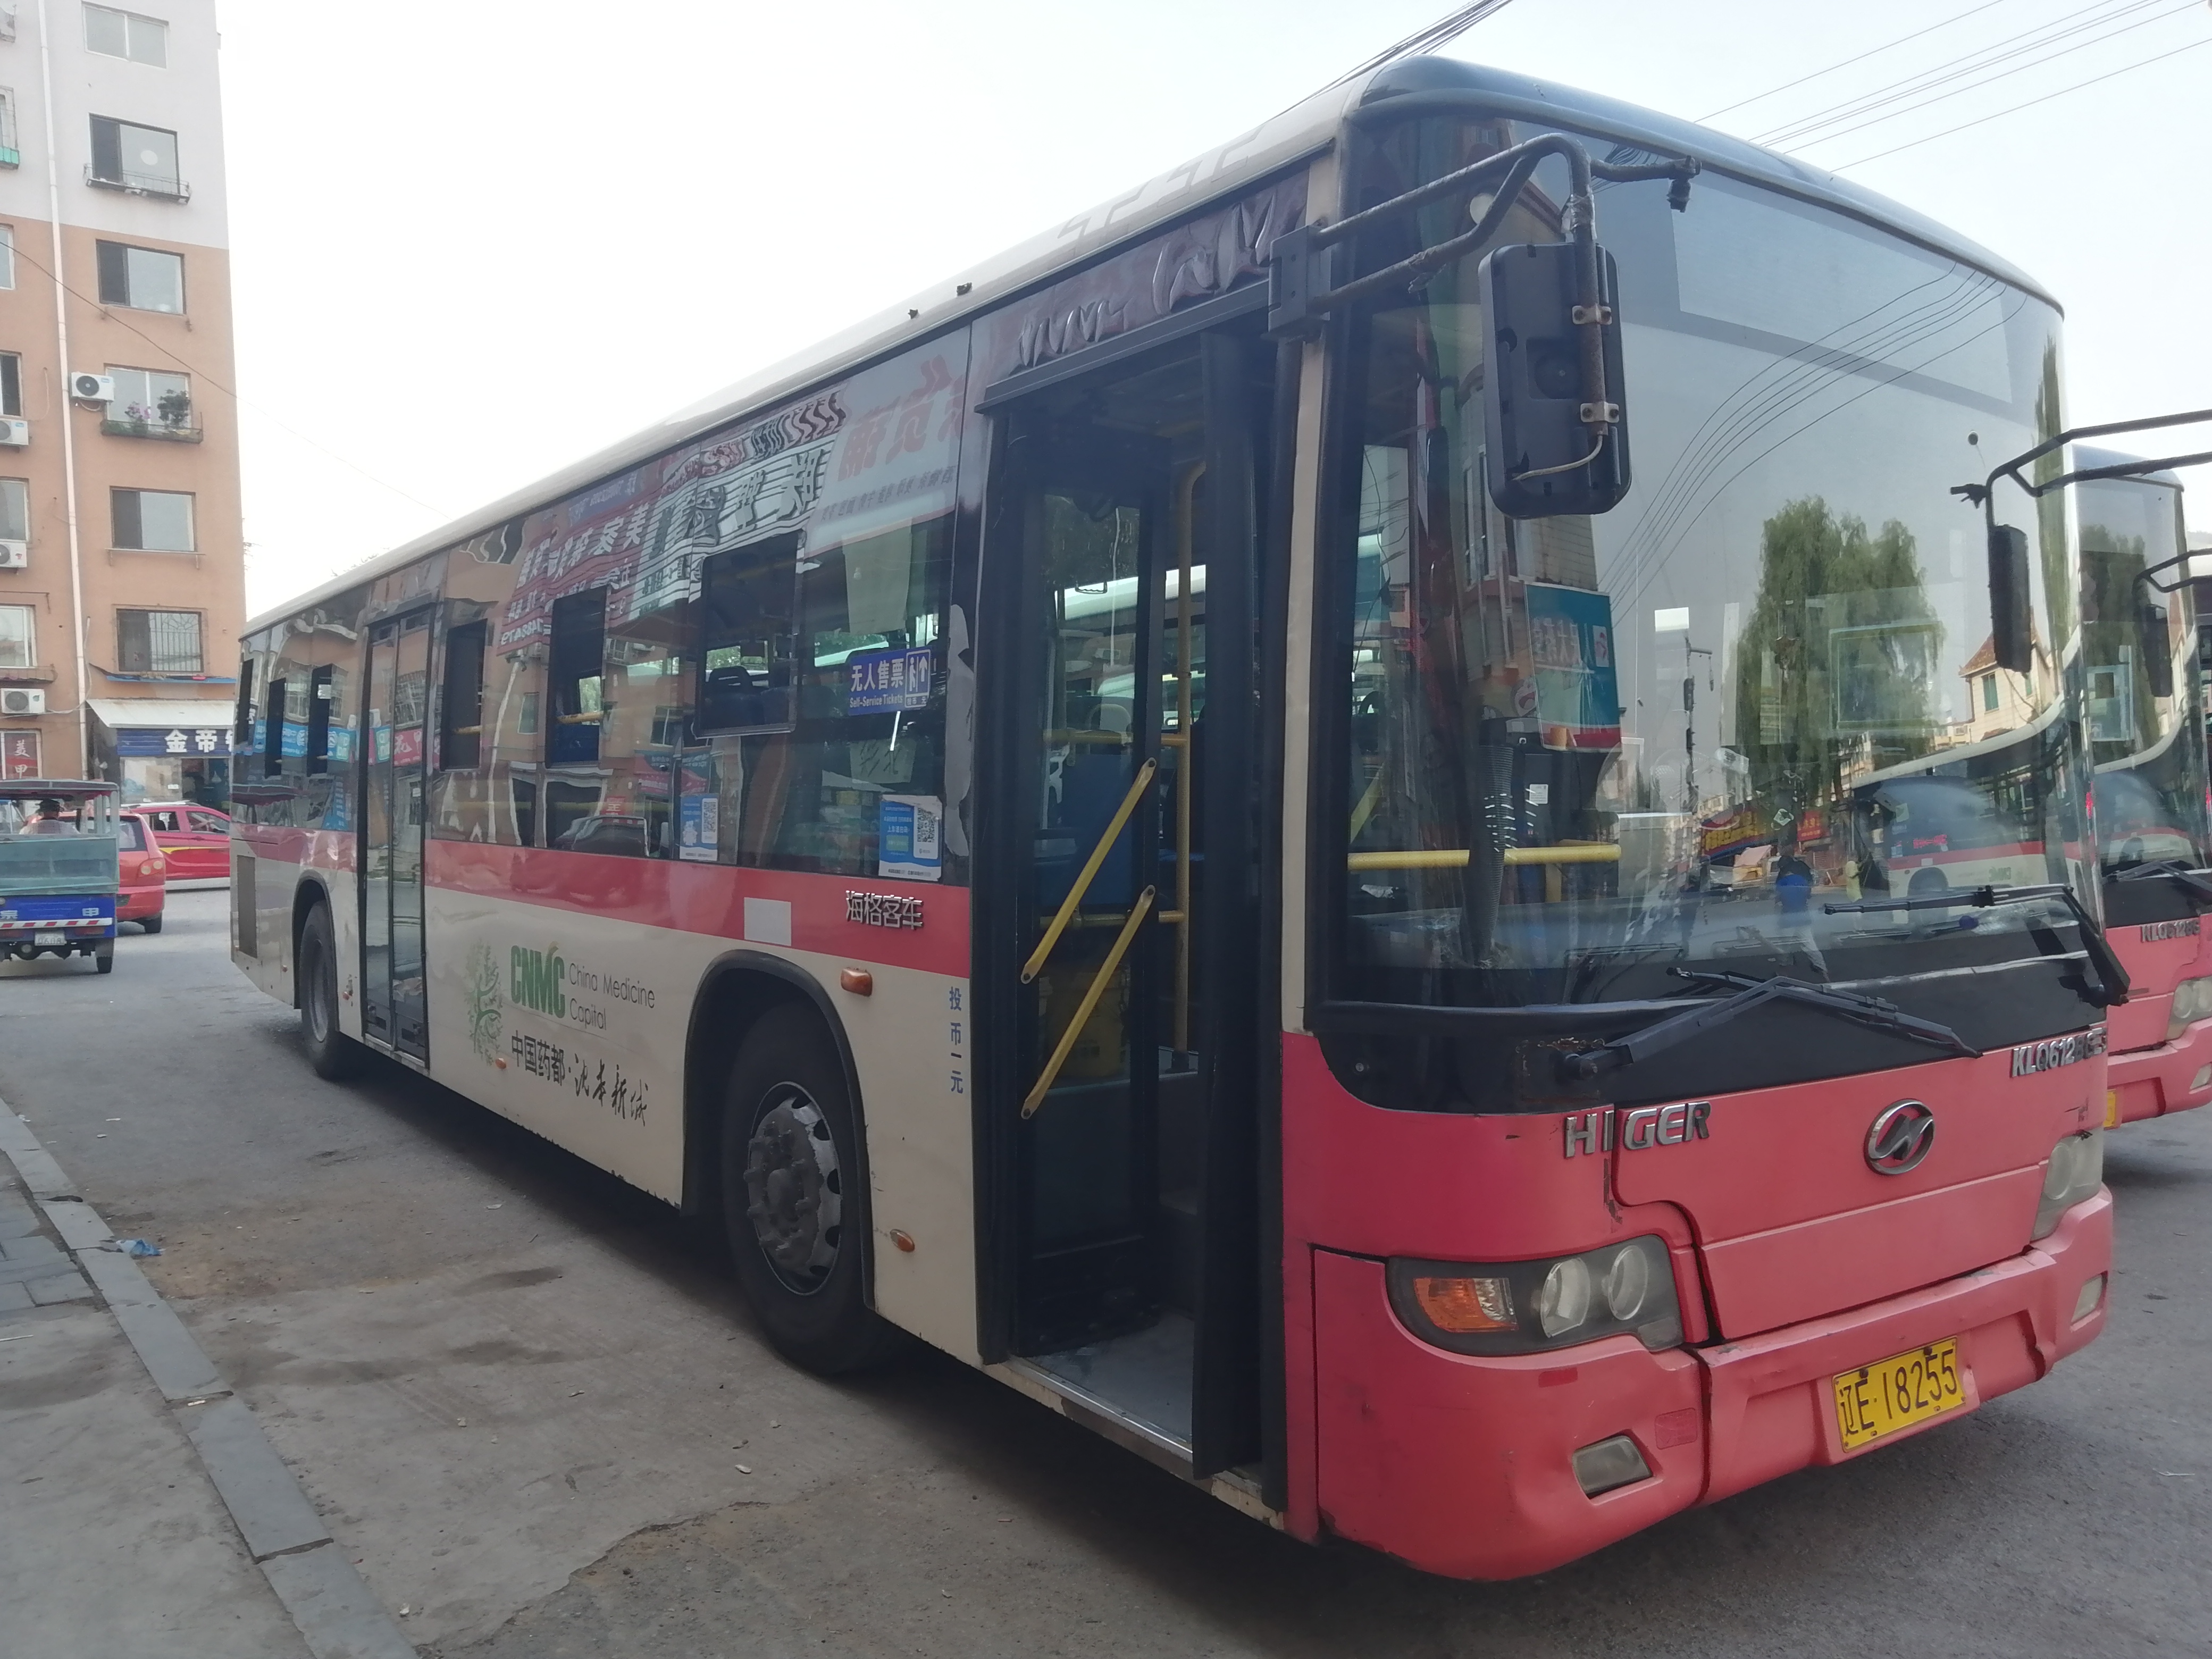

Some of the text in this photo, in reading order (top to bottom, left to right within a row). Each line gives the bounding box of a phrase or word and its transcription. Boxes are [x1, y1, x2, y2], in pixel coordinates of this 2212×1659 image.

[851, 658, 904, 692] 无人售票
[850, 694, 903, 708] Self-Service Tickets
[14, 739, 30, 779] 美甲
[846, 890, 923, 929] 海格客车
[510, 942, 566, 1019] CNMC
[569, 963, 656, 1009] China Medicine
[569, 998, 607, 1030] Capital
[949, 986, 963, 1094] 投币一元
[1564, 1101, 1712, 1159] HIGER
